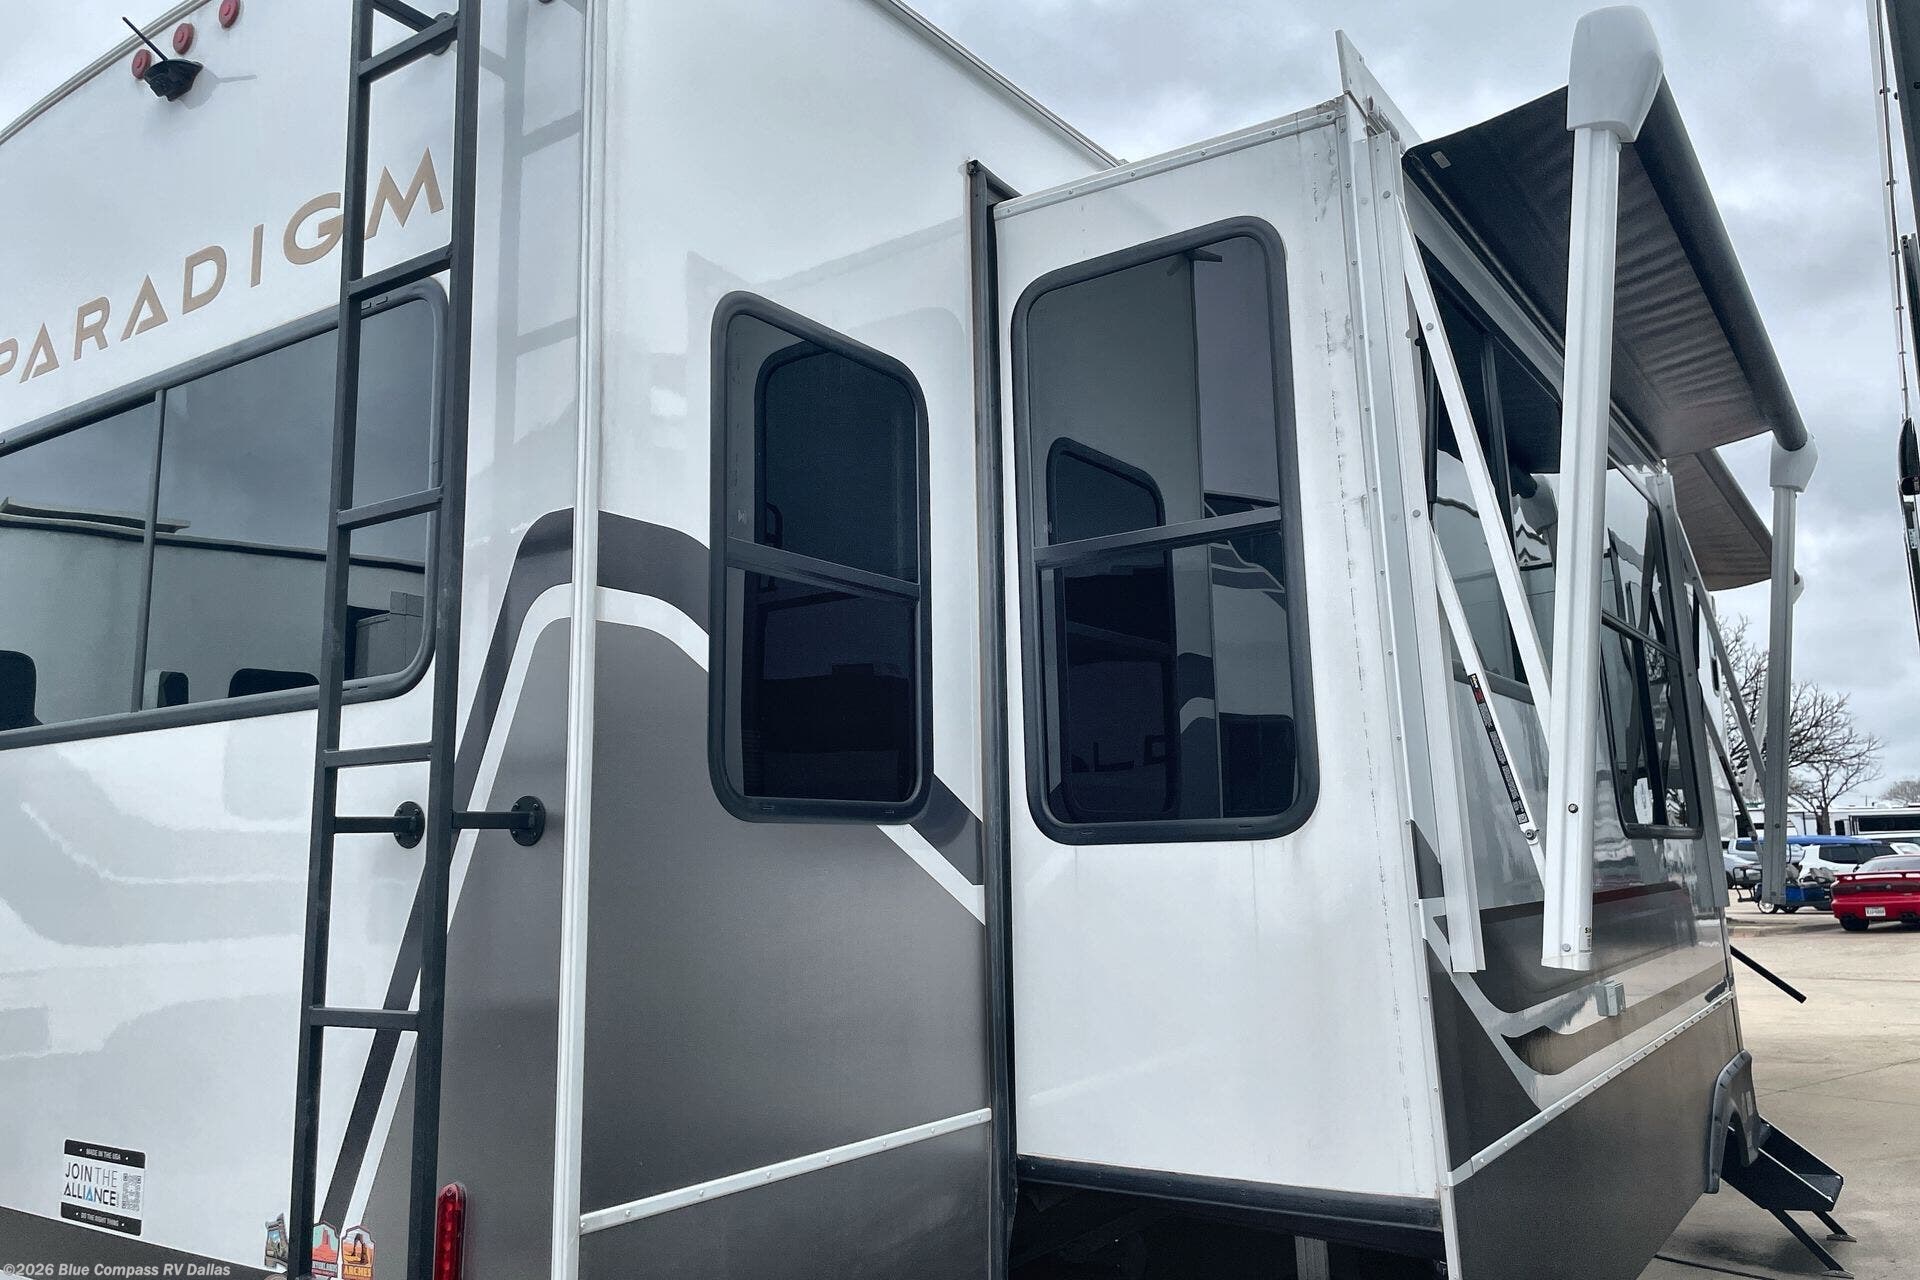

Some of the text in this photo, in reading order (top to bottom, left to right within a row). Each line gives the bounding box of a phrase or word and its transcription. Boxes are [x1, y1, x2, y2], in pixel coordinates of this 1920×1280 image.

[65, 1162, 118, 1187] JOIN THE
[64, 1182, 117, 1206] ALLIANCE
